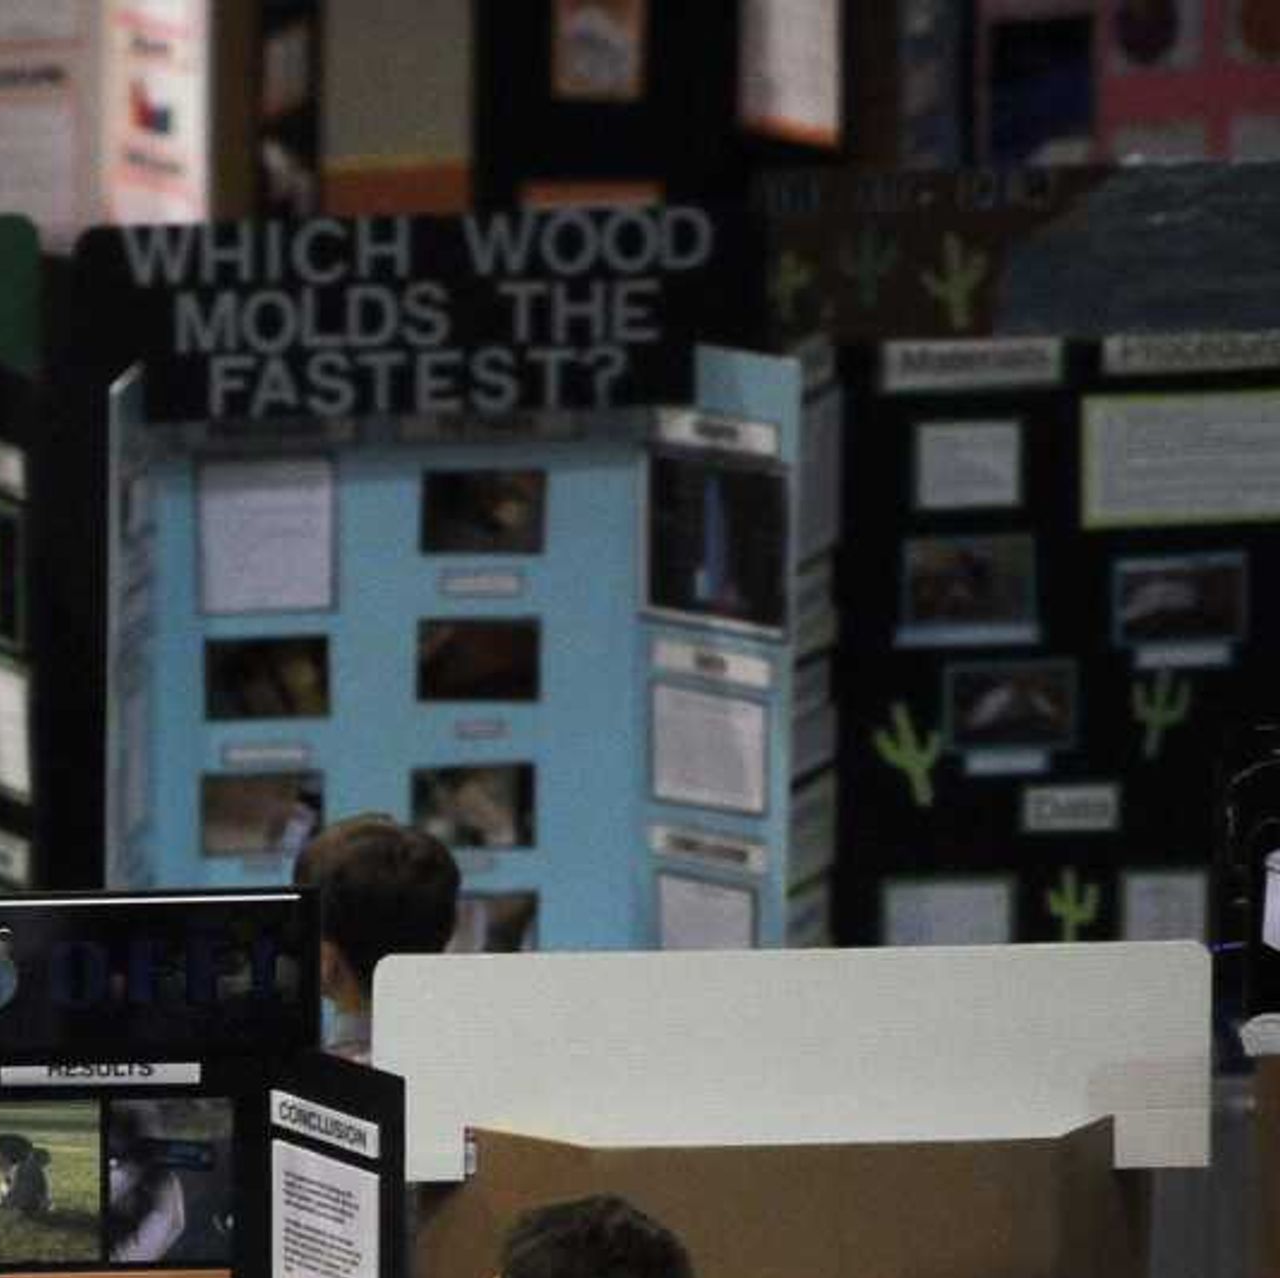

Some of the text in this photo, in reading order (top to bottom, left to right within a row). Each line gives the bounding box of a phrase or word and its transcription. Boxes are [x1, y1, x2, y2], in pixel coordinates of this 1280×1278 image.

[121, 206, 713, 285] WHICH WOOD
[172, 279, 661, 353] MOLDS THE
[206, 344, 629, 418] FASTEST?
[279, 1099, 367, 1152] CONCLUSION
